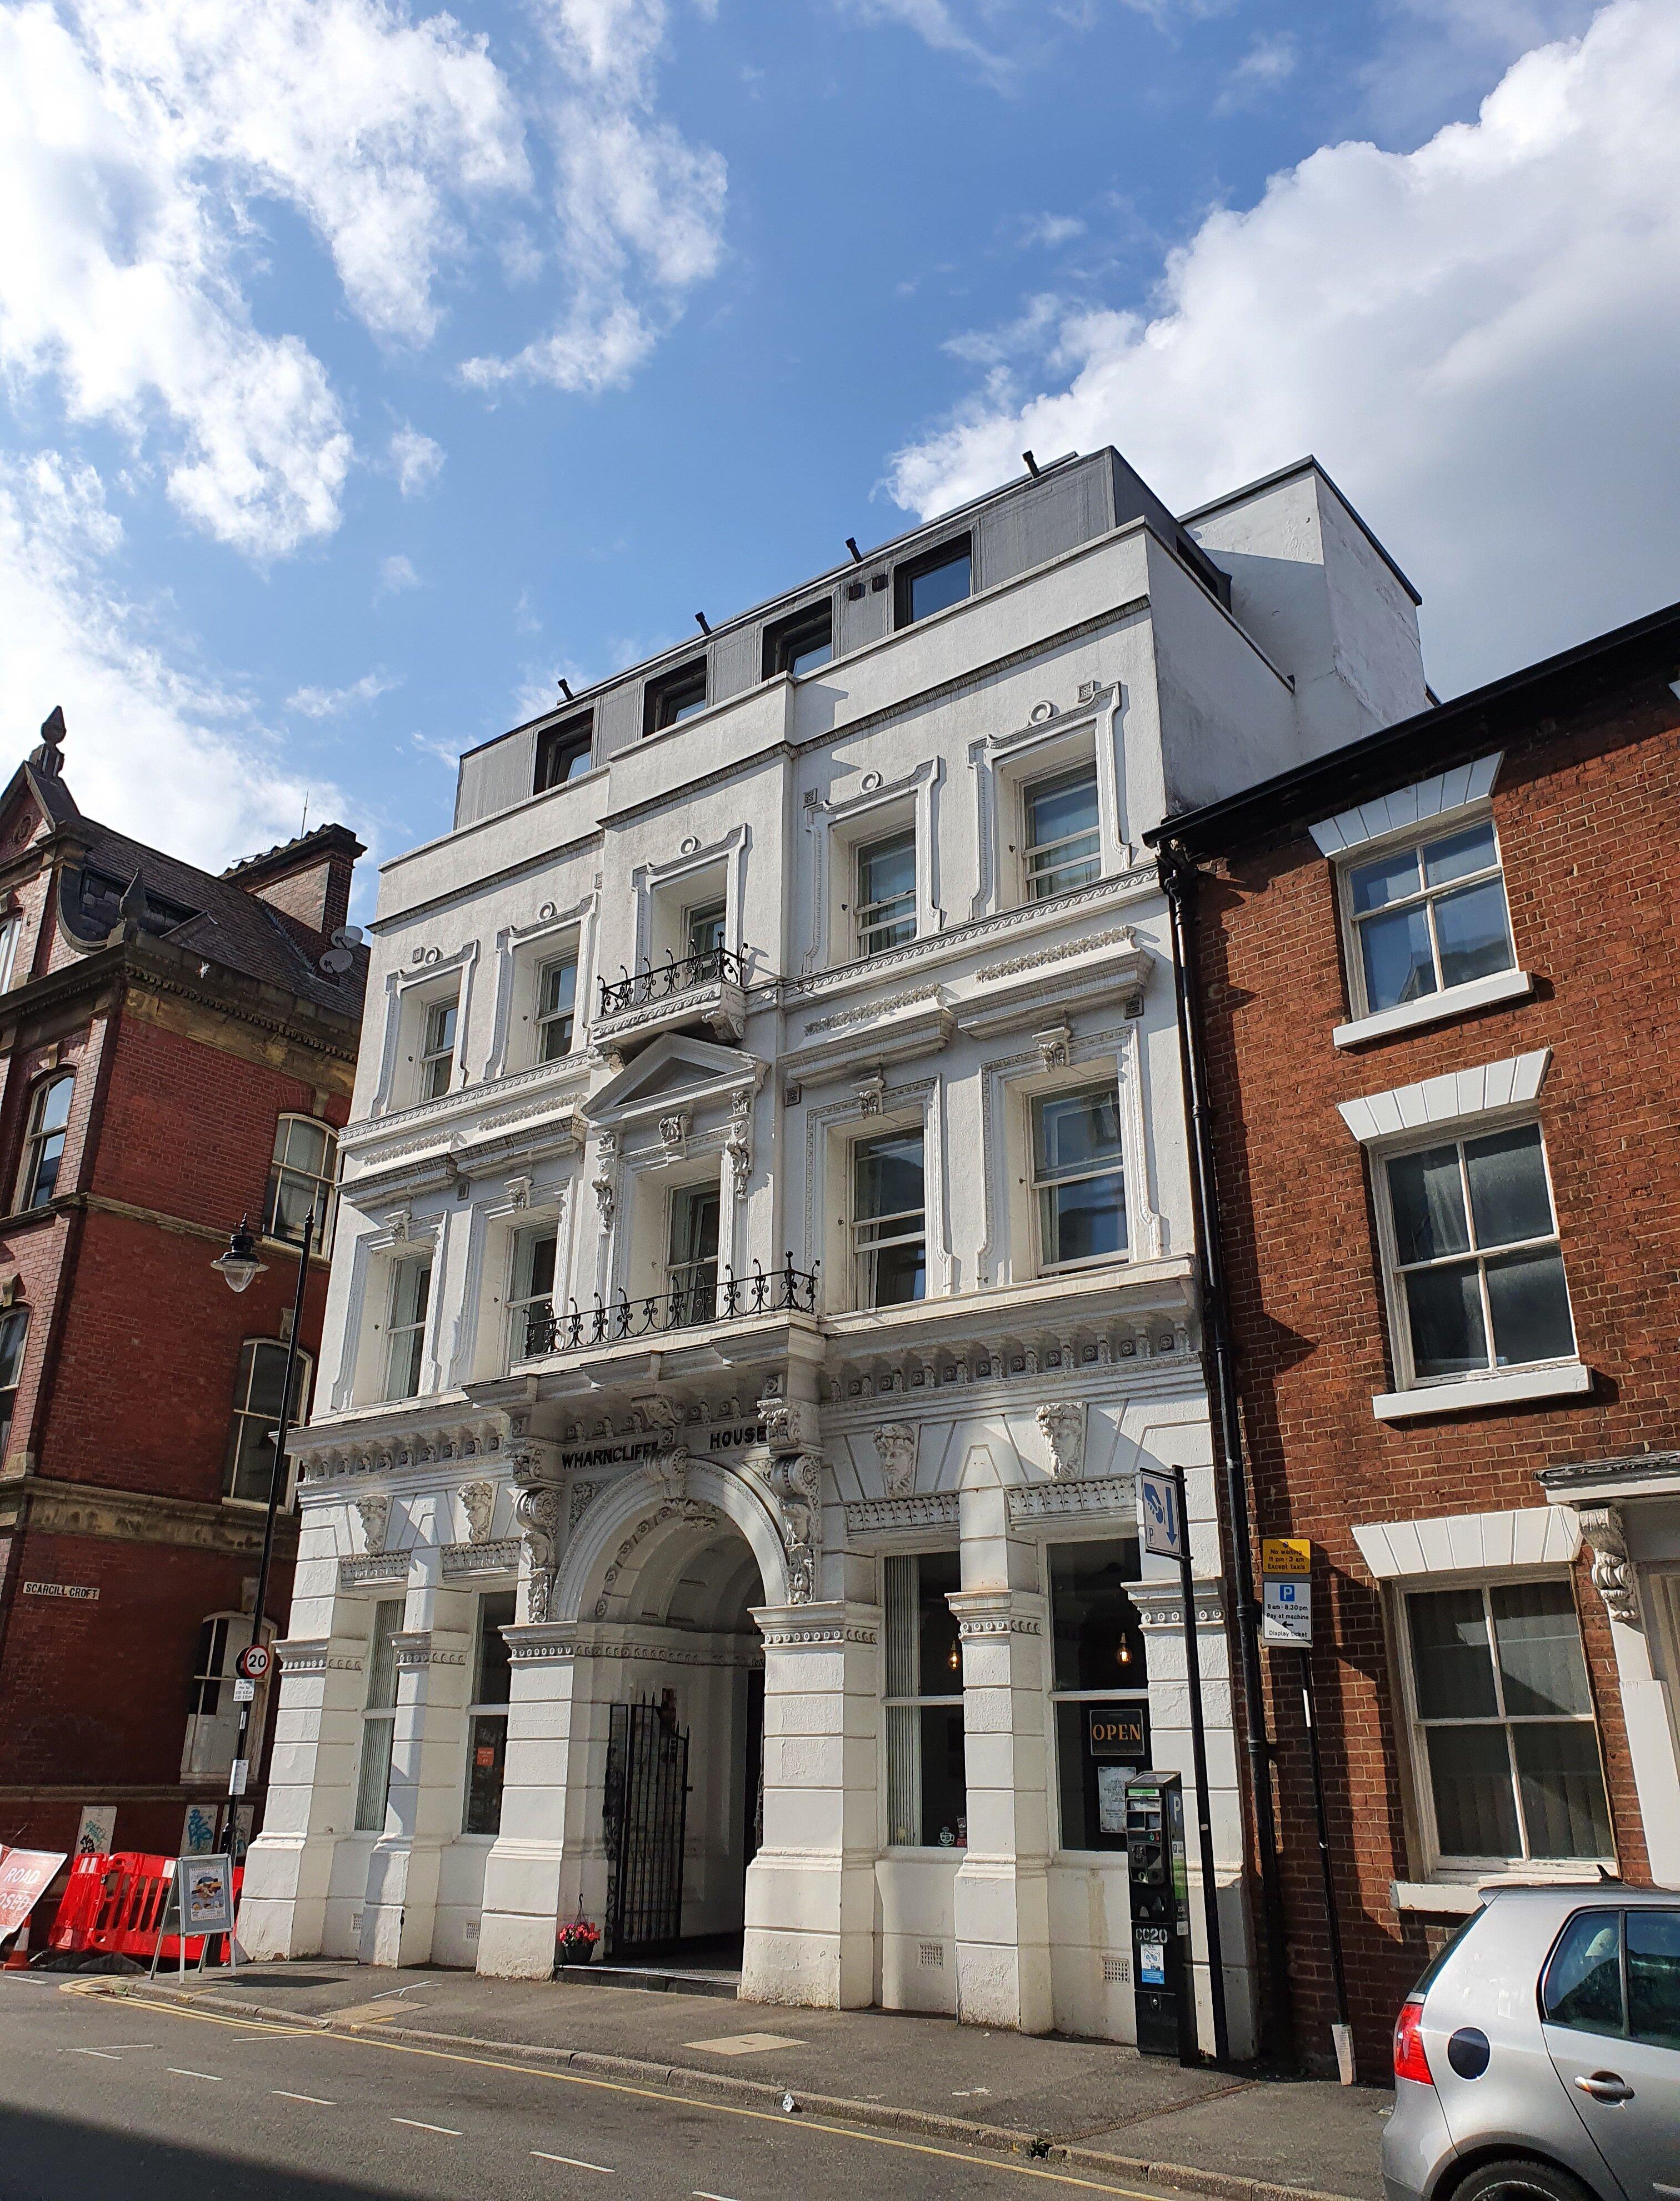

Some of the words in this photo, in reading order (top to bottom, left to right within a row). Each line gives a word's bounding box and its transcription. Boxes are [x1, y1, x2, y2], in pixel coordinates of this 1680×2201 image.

[709, 1425, 768, 1450] HOUSE
[1148, 1527, 1154, 1542] P
[69, 1587, 98, 1598] CROFT
[1283, 1586, 1293, 1600] P
[248, 1654, 267, 1668] 20
[1092, 1724, 1141, 1740] OPEN
[1173, 1795, 1182, 1822] P
[3, 1867, 41, 1884] ROAD
[1135, 1927, 1168, 1944] CC20
